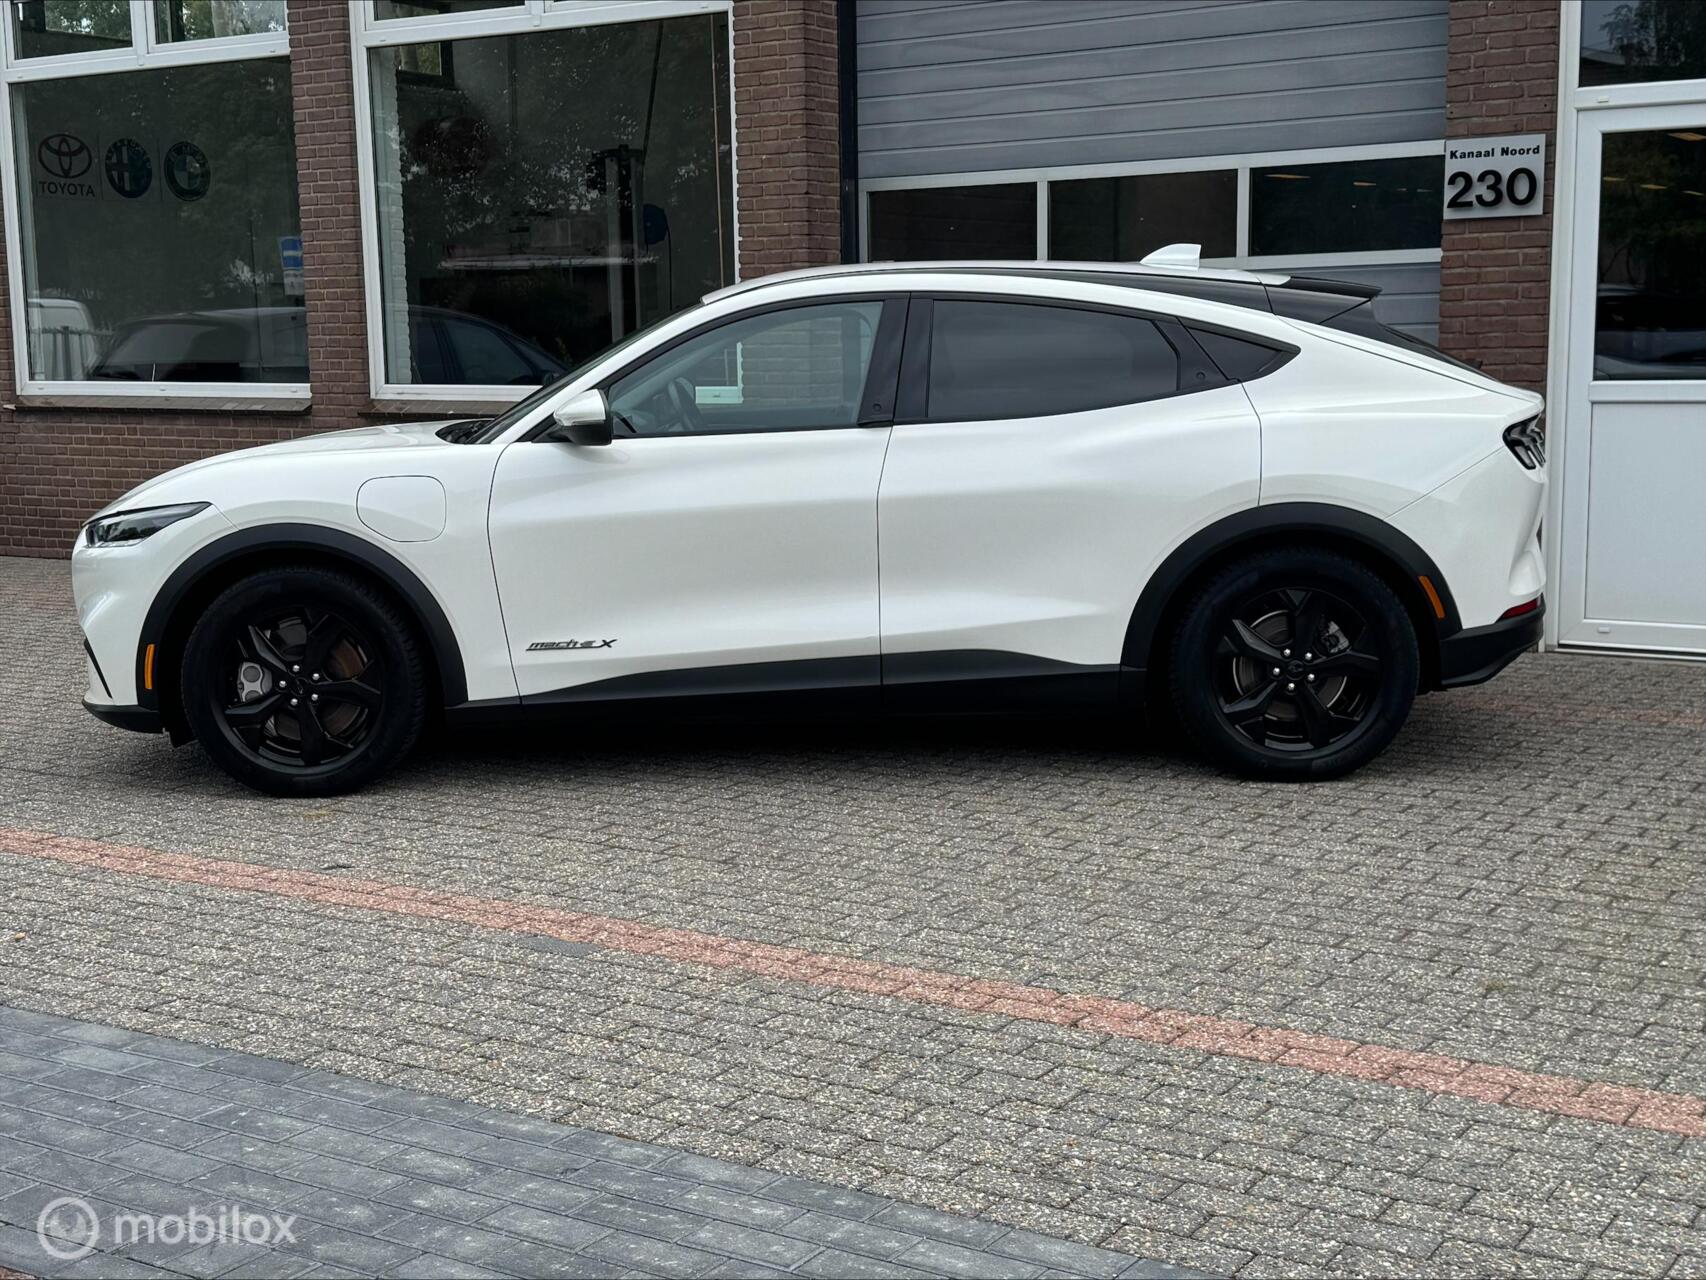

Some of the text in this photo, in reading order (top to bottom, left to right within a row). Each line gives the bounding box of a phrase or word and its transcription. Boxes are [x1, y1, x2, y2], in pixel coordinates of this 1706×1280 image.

[1449, 145, 1540, 160] Kanaal Noord
[39, 181, 95, 198] TOYOTA
[1447, 167, 1537, 208] 230
